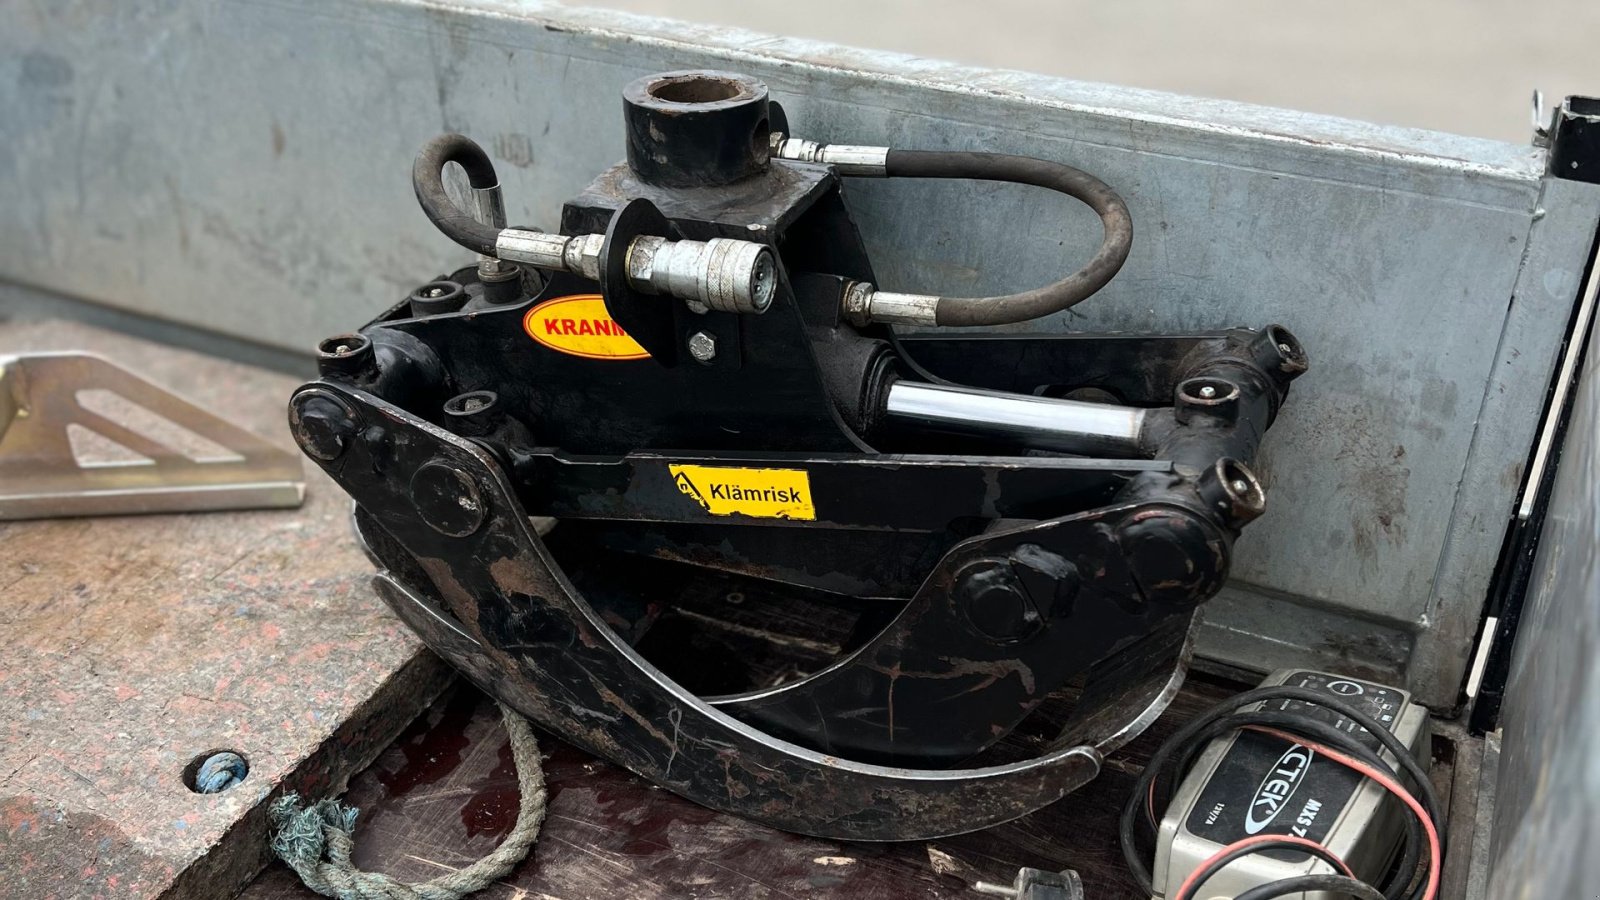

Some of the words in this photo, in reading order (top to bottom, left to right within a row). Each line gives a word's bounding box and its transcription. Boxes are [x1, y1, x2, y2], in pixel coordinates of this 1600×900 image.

[709, 483, 802, 503] Klämrisk
[1254, 752, 1307, 812] CTEK
[1204, 802, 1226, 826] 12V/7A
[1296, 798, 1323, 827] MXS
